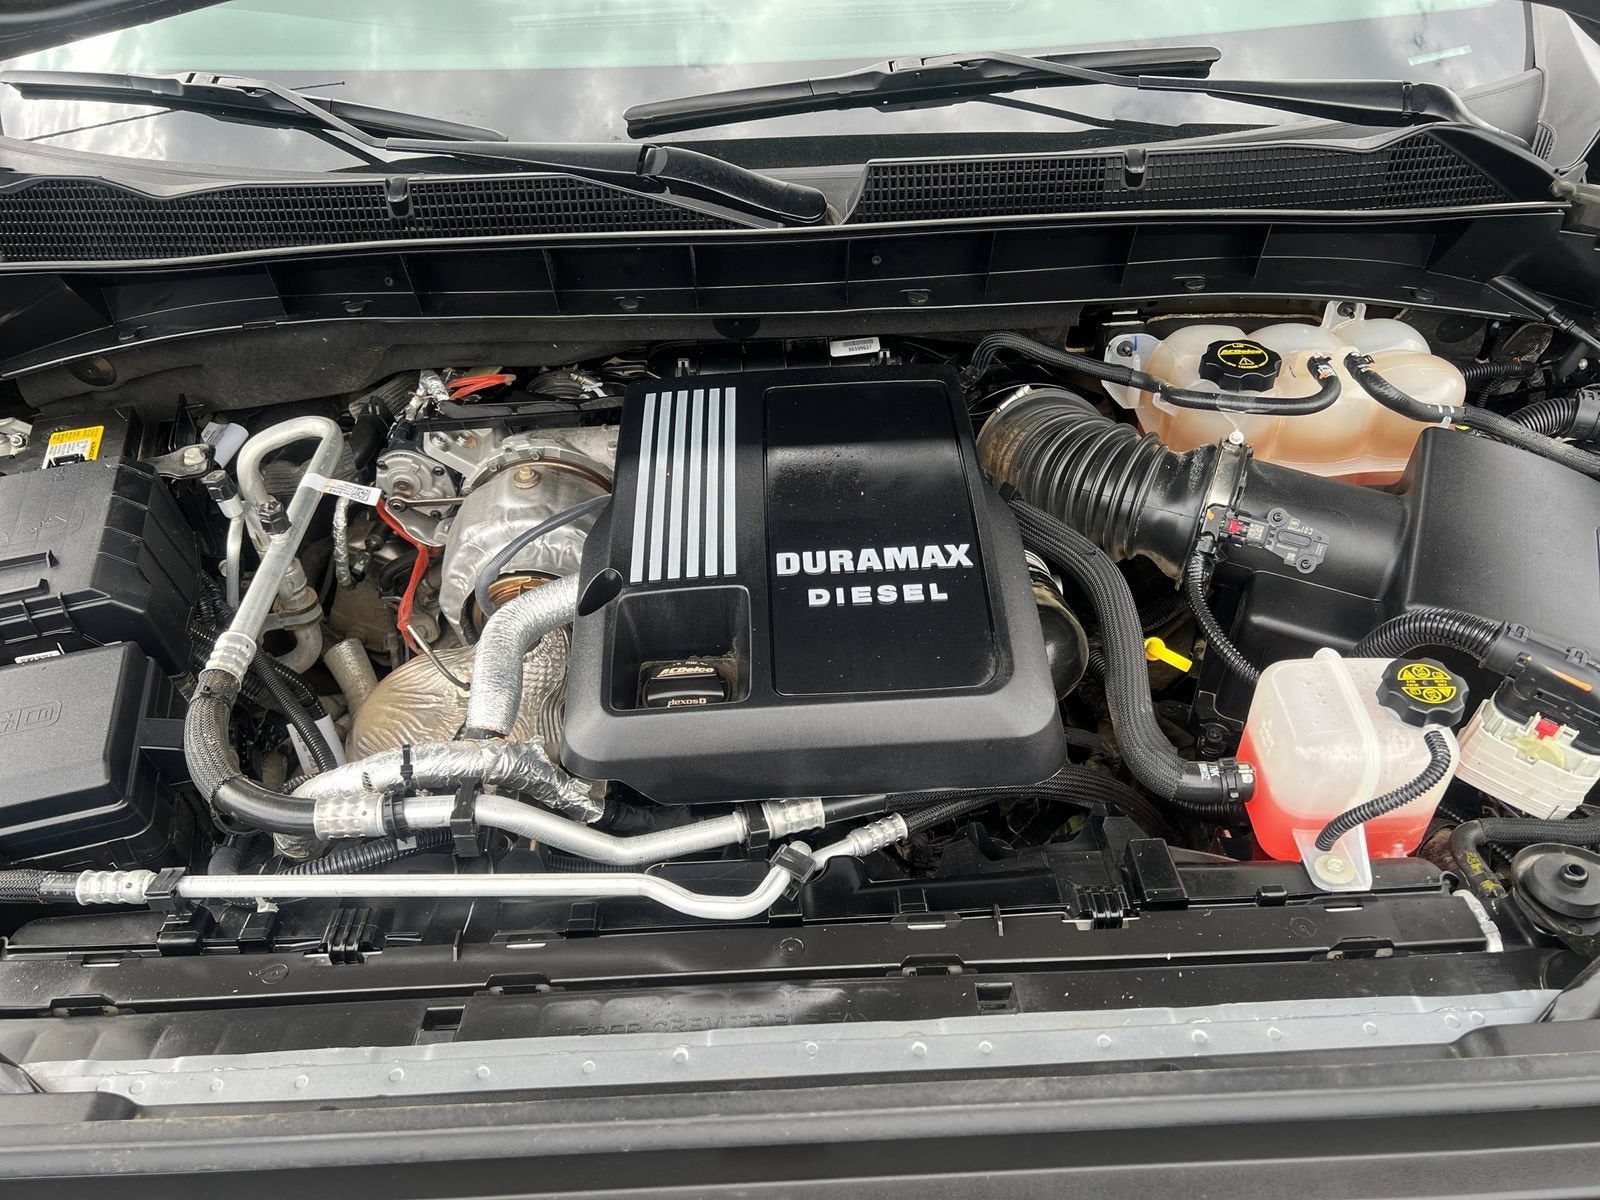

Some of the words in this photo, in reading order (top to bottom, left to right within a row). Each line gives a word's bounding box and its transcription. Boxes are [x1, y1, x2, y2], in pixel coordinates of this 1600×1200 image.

[776, 544, 974, 576] DURAMAX
[808, 583, 948, 608] DIESEL
[657, 666, 715, 678] ACDelco
